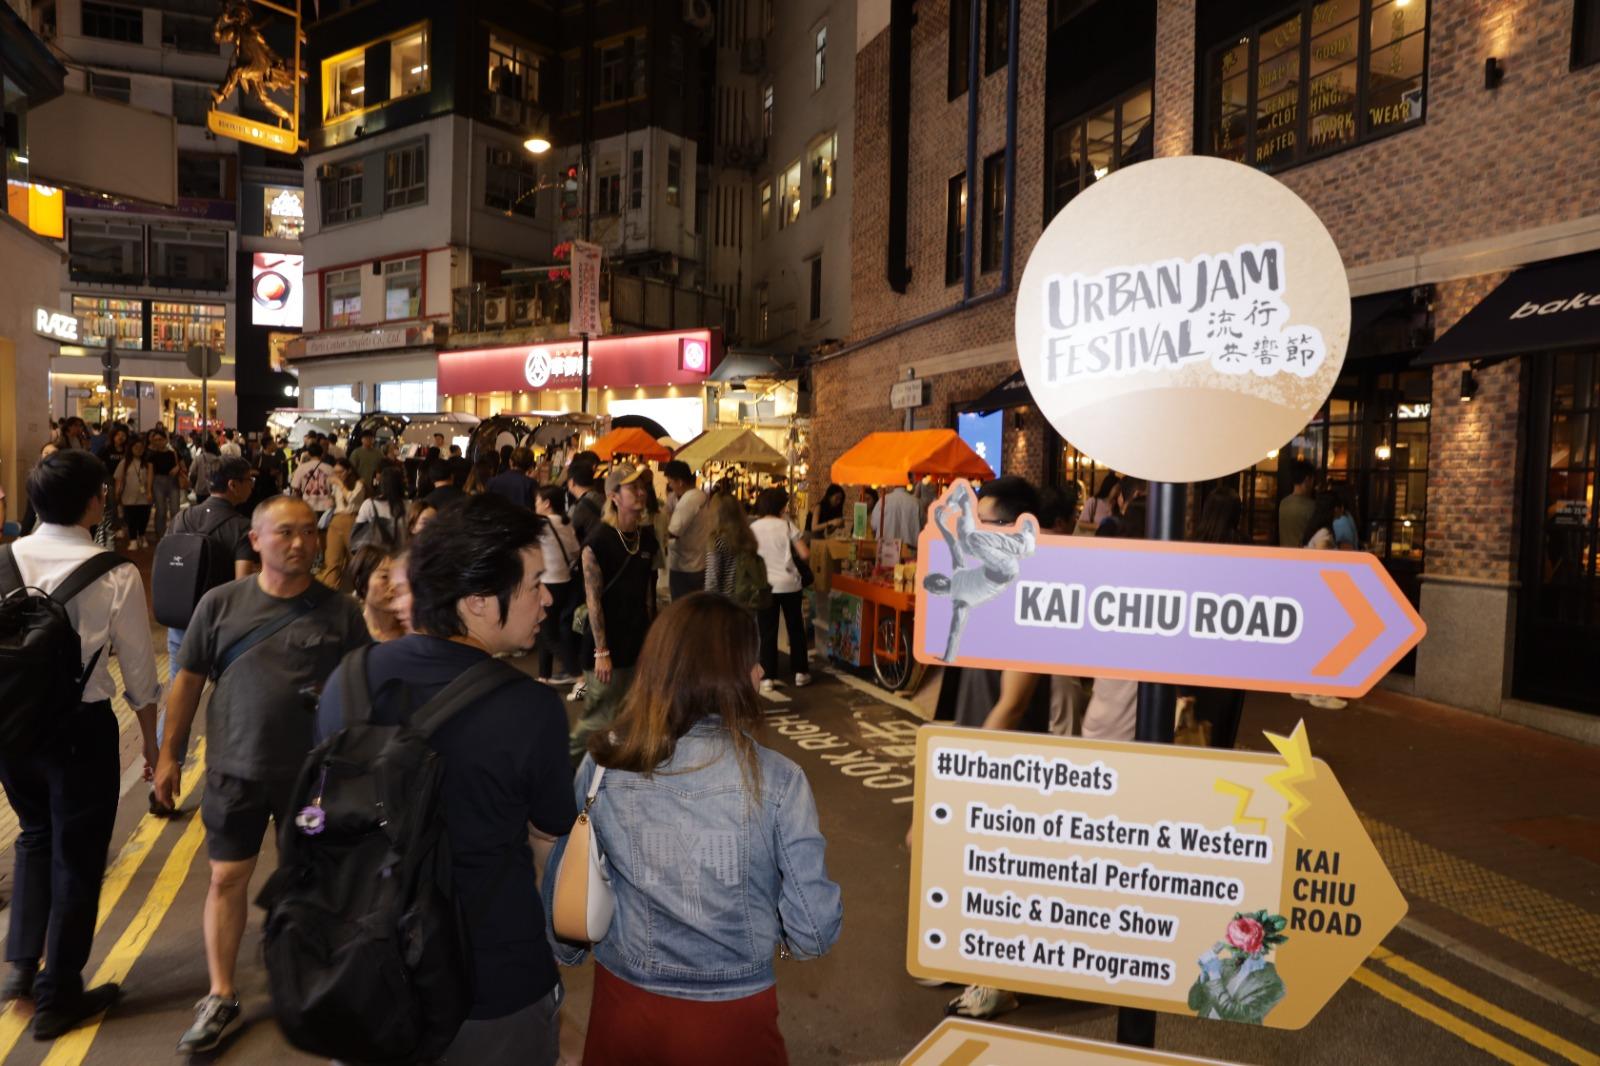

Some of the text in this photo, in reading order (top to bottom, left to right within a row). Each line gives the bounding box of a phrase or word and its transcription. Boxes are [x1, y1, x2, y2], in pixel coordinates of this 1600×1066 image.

[1049, 248, 1279, 330] URBAN JAM
[36, 308, 78, 340] RAZE
[1207, 300, 1278, 339] 流行
[1047, 319, 1204, 382] FESTIVAL
[1020, 586, 1298, 638] KAI CHIU ROAD
[937, 752, 1113, 790] #UrbanCityBeats
[969, 807, 1268, 859] Fusion of Eastern & Western
[968, 849, 1239, 901] Instrumental Performance
[1295, 848, 1340, 875] KAI
[966, 892, 1173, 937] Music & Dance Show
[1292, 878, 1356, 907] CHIU
[1290, 907, 1362, 937] ROAD
[963, 934, 1171, 980] Street Art Programs
